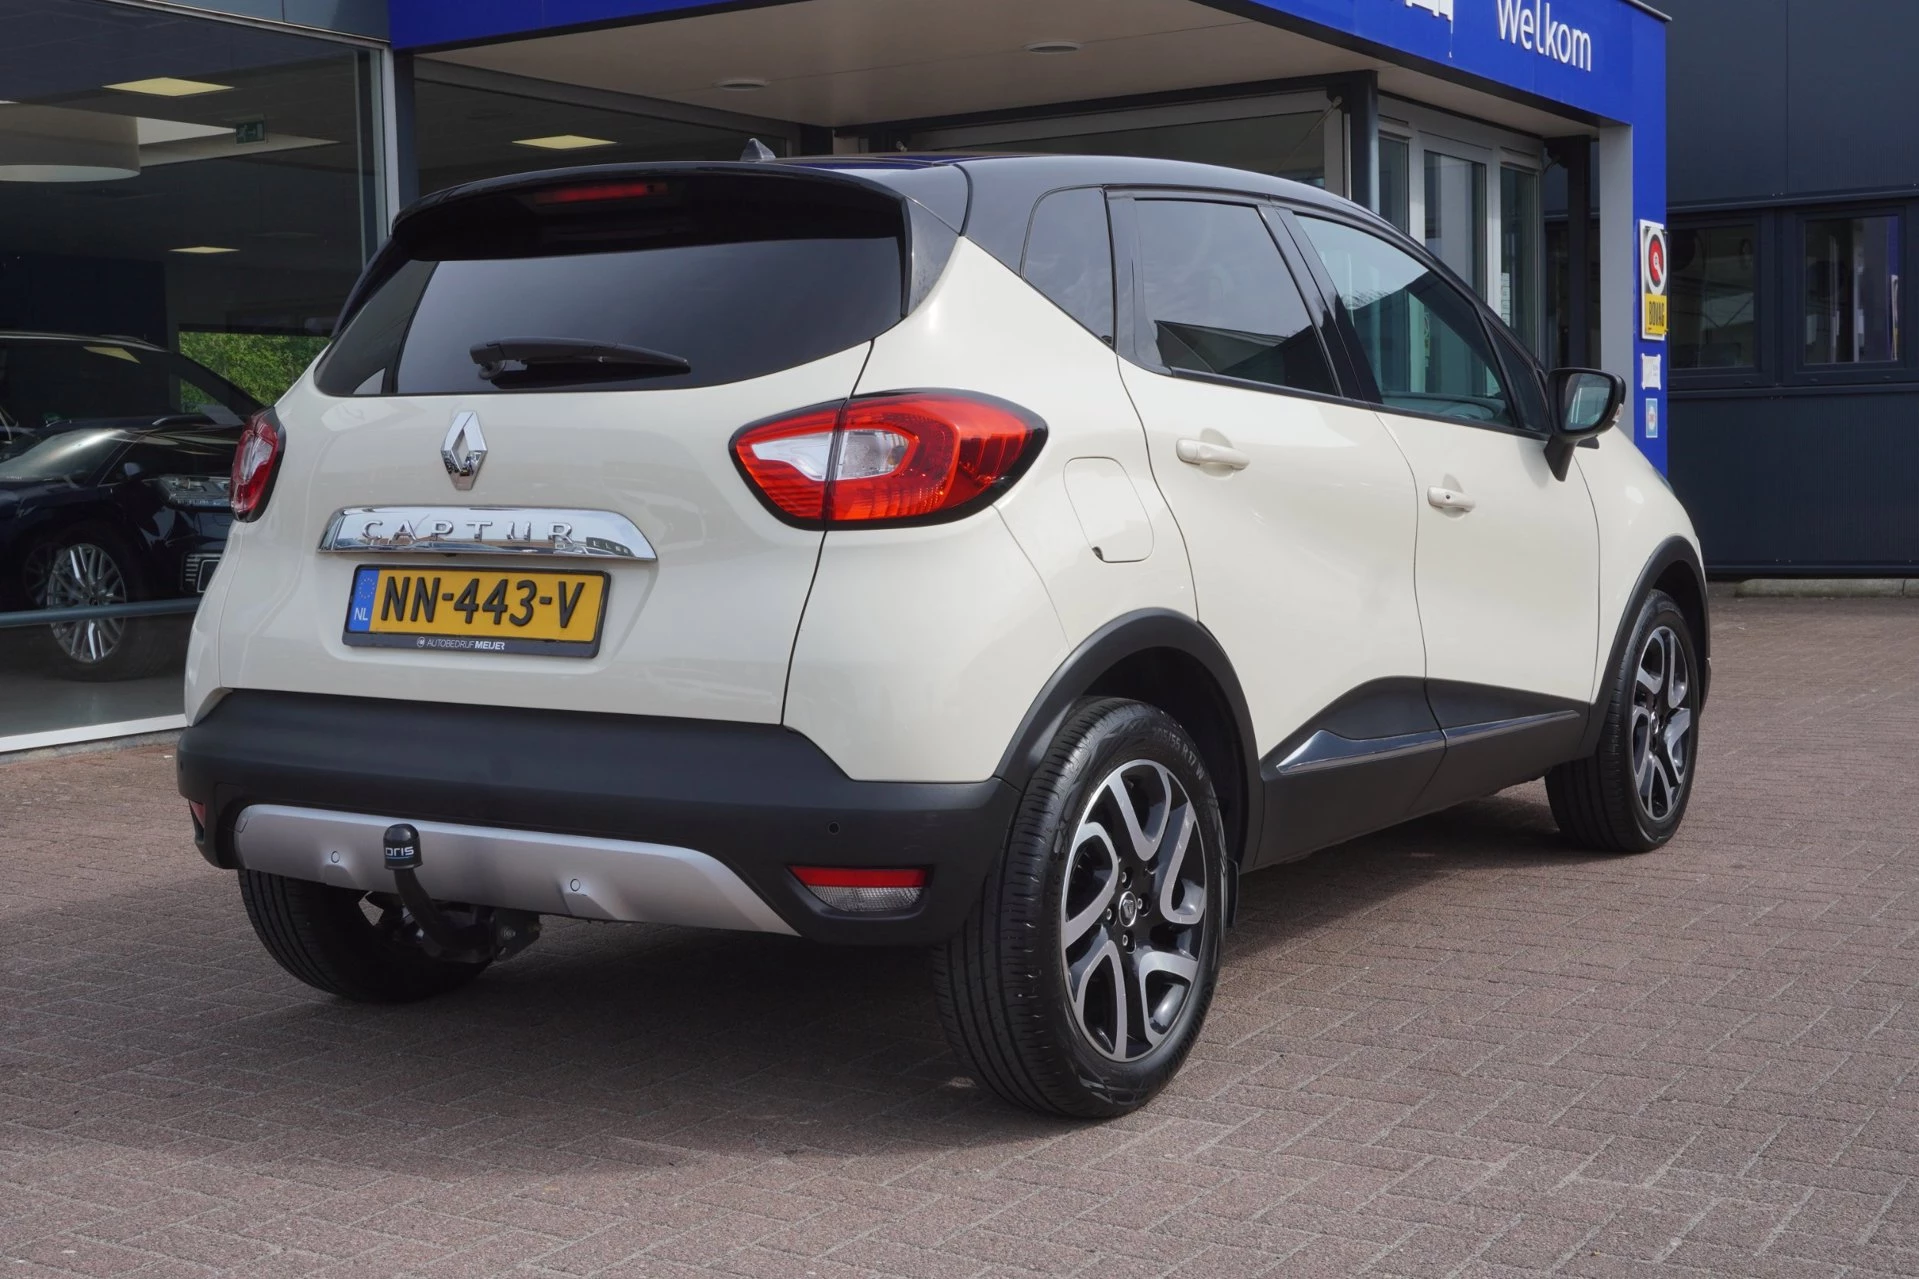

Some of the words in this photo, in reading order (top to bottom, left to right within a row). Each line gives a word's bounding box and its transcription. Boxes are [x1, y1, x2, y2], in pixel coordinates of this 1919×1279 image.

[1498, 0, 1591, 72] Welkom
[362, 519, 574, 544] CAPTUR
[354, 608, 369, 621] NL
[381, 576, 585, 629] NN-443-V
[427, 638, 475, 649] AUTOBEDRIJF
[475, 641, 505, 651] MEIJER
